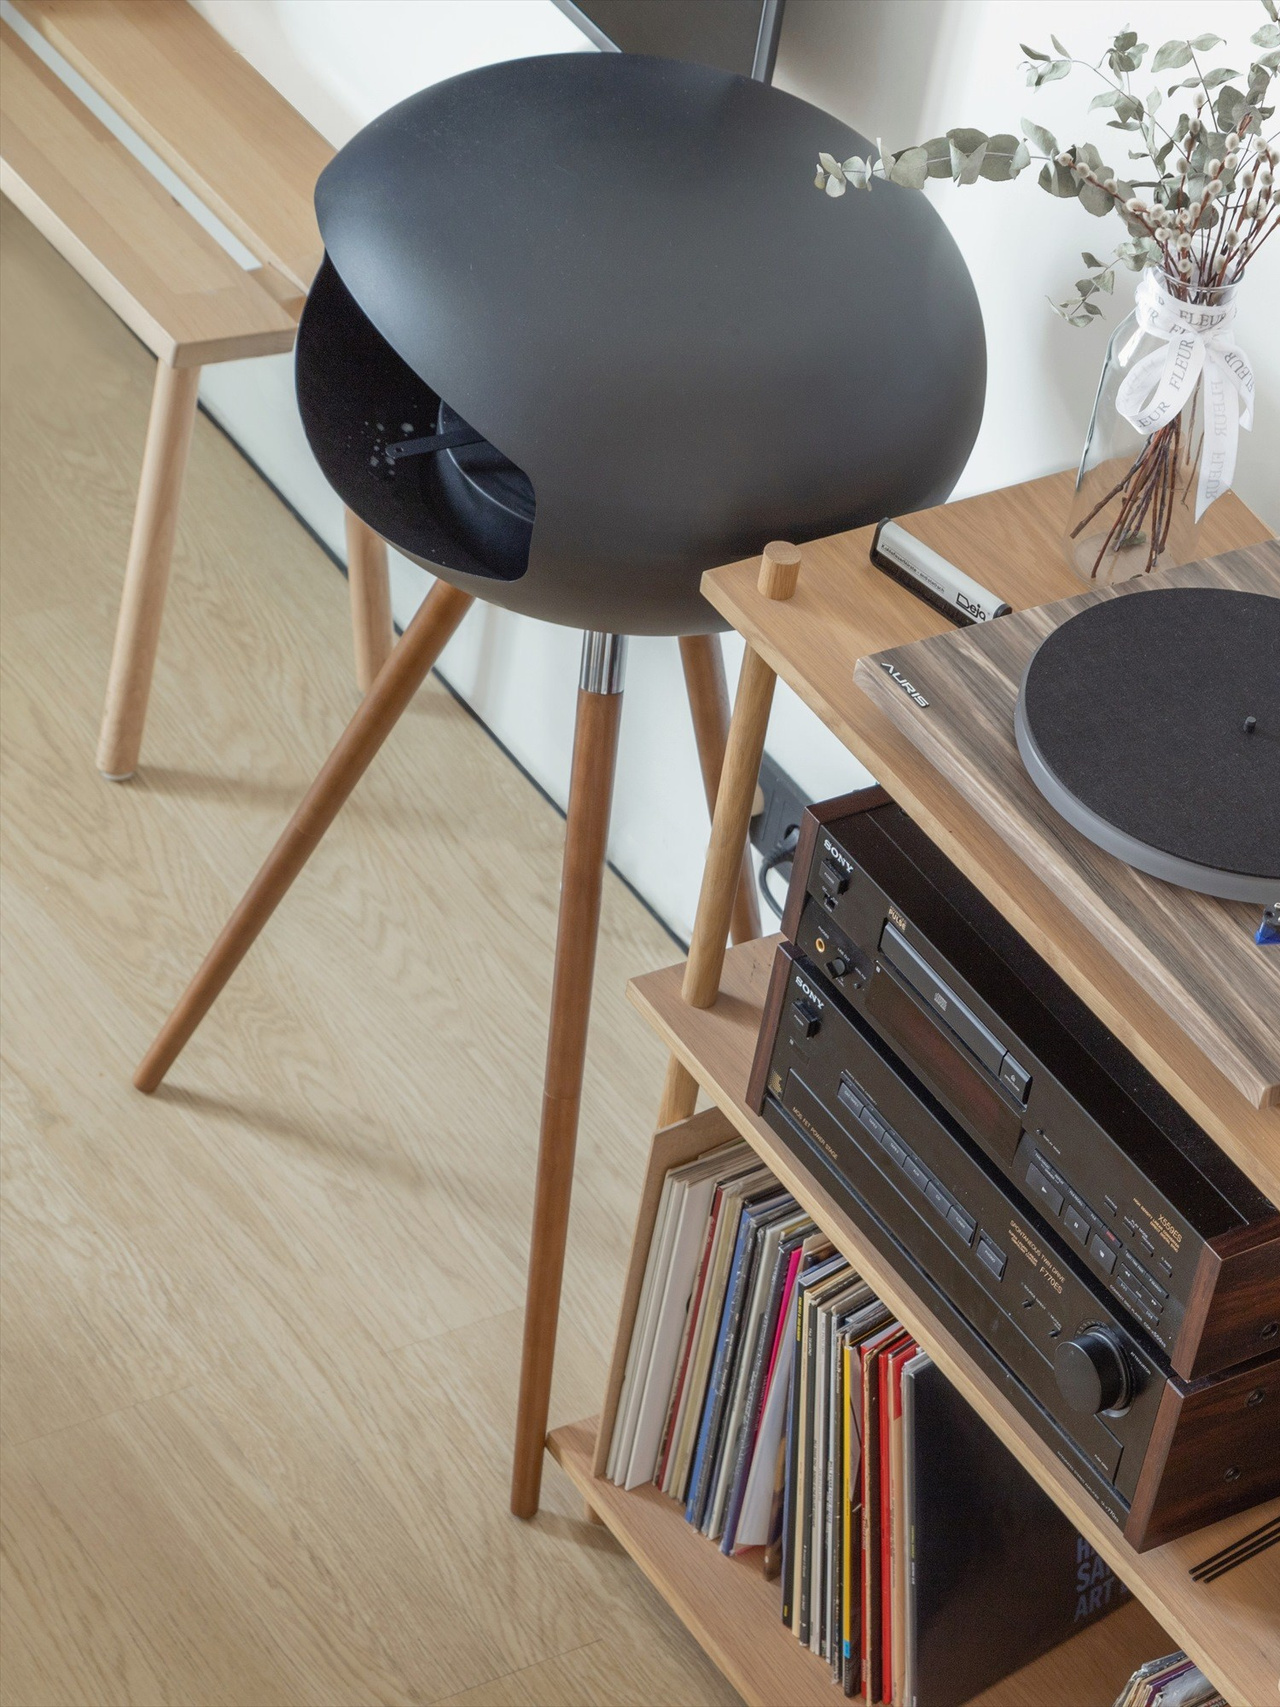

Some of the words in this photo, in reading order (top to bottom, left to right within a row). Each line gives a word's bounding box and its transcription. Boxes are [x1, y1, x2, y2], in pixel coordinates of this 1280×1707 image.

[1180, 309, 1227, 327] FLEUR
[1169, 339, 1195, 391] FLEUR
[1138, 401, 1171, 428] EUR
[881, 661, 930, 708] AURIS
[824, 838, 852, 875] SONY
[888, 907, 905, 931] PULSE
[795, 974, 823, 1011] SONY
[810, 1126, 824, 1146] POWER
[1158, 1212, 1182, 1243] X559ES
[1039, 1265, 1062, 1295] F770ES
